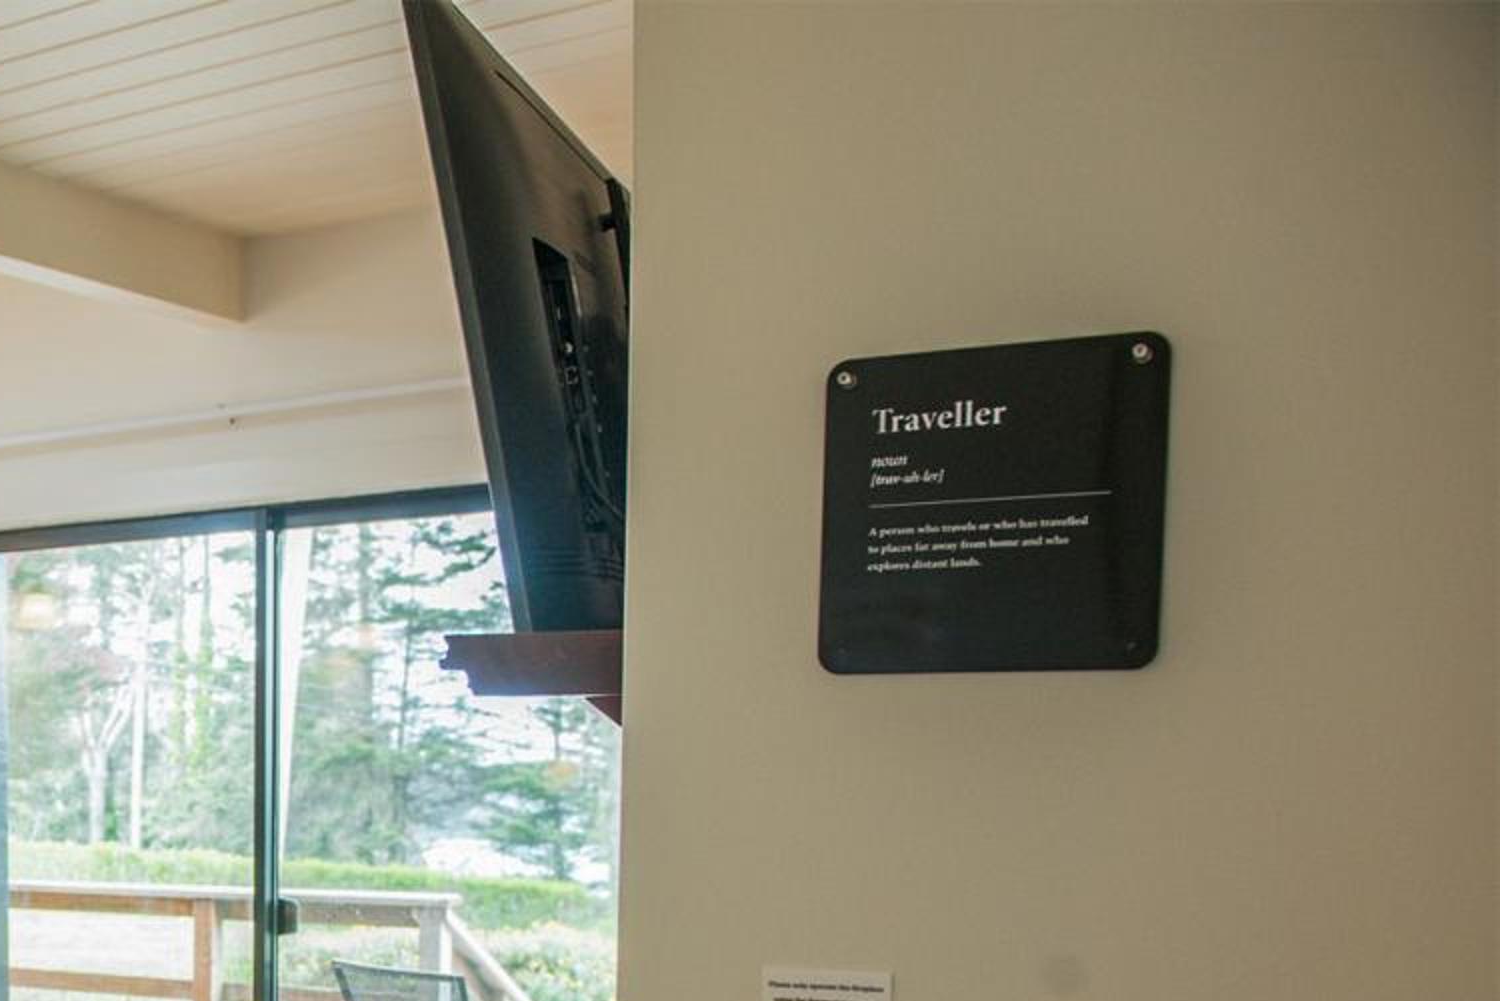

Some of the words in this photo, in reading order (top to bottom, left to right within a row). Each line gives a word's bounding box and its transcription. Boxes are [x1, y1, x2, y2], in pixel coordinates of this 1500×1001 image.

[871, 399, 1008, 434] Traveller
[871, 455, 908, 467] noun
[868, 527, 877, 536] A
[879, 527, 915, 538] person
[917, 522, 940, 533] who
[941, 520, 976, 533] travels
[978, 523, 990, 531] or
[994, 520, 1017, 529] who
[1018, 518, 1038, 529] has
[1040, 515, 1089, 527] travelled
[867, 545, 879, 554] to
[881, 543, 913, 556] places
[914, 541, 930, 551] far
[931, 543, 957, 554] away
[960, 540, 987, 550] from
[989, 537, 1019, 548] home
[1021, 535, 1043, 547] and
[1045, 535, 1070, 545] who
[867, 560, 911, 573] explores
[912, 558, 949, 569] distant
[950, 556, 982, 568] lands.
